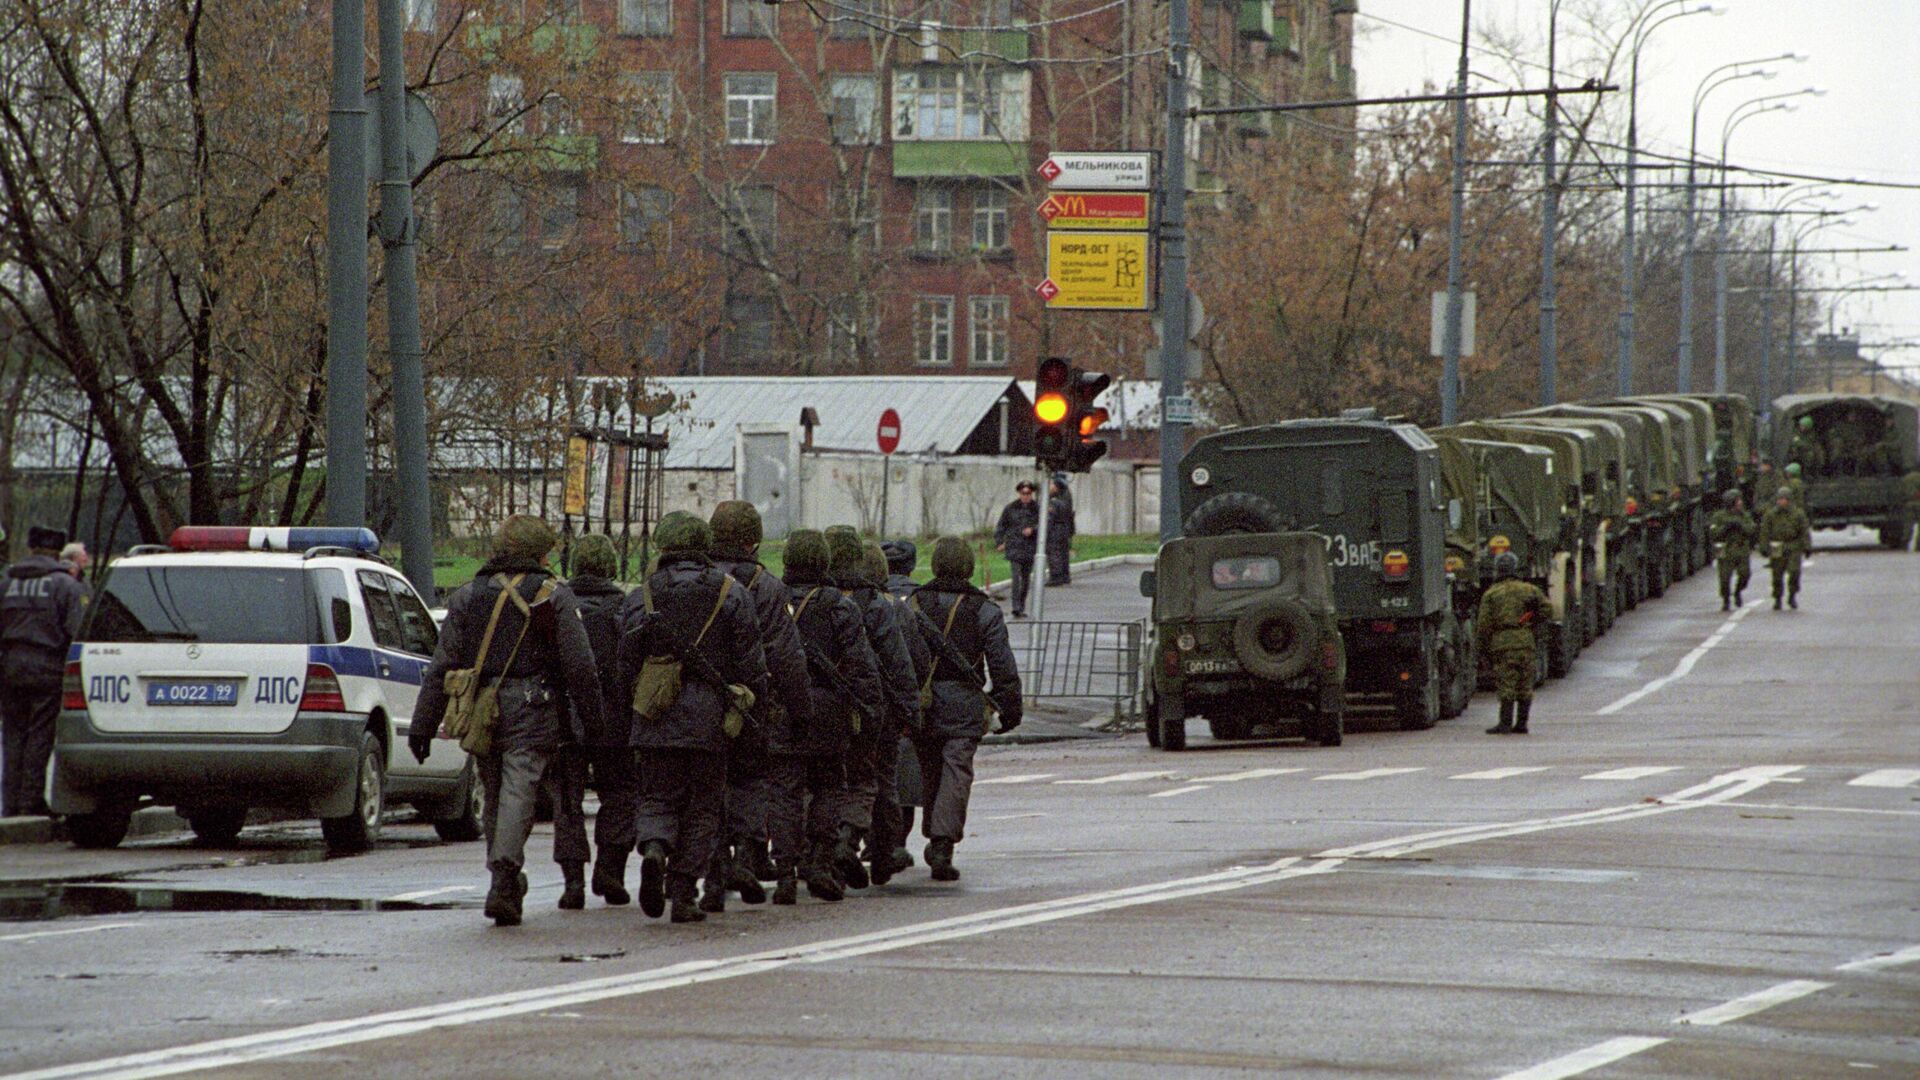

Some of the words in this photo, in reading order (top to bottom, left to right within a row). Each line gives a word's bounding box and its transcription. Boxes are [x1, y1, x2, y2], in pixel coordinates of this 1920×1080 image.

[1065, 161, 1142, 170] МЕЛЬНИКОВА
[5, 577, 52, 597] ДПС
[89, 675, 130, 703] ДПС
[170, 685, 207, 700] 0022
[216, 684, 232, 696] 99
[255, 676, 299, 704] ДПС
